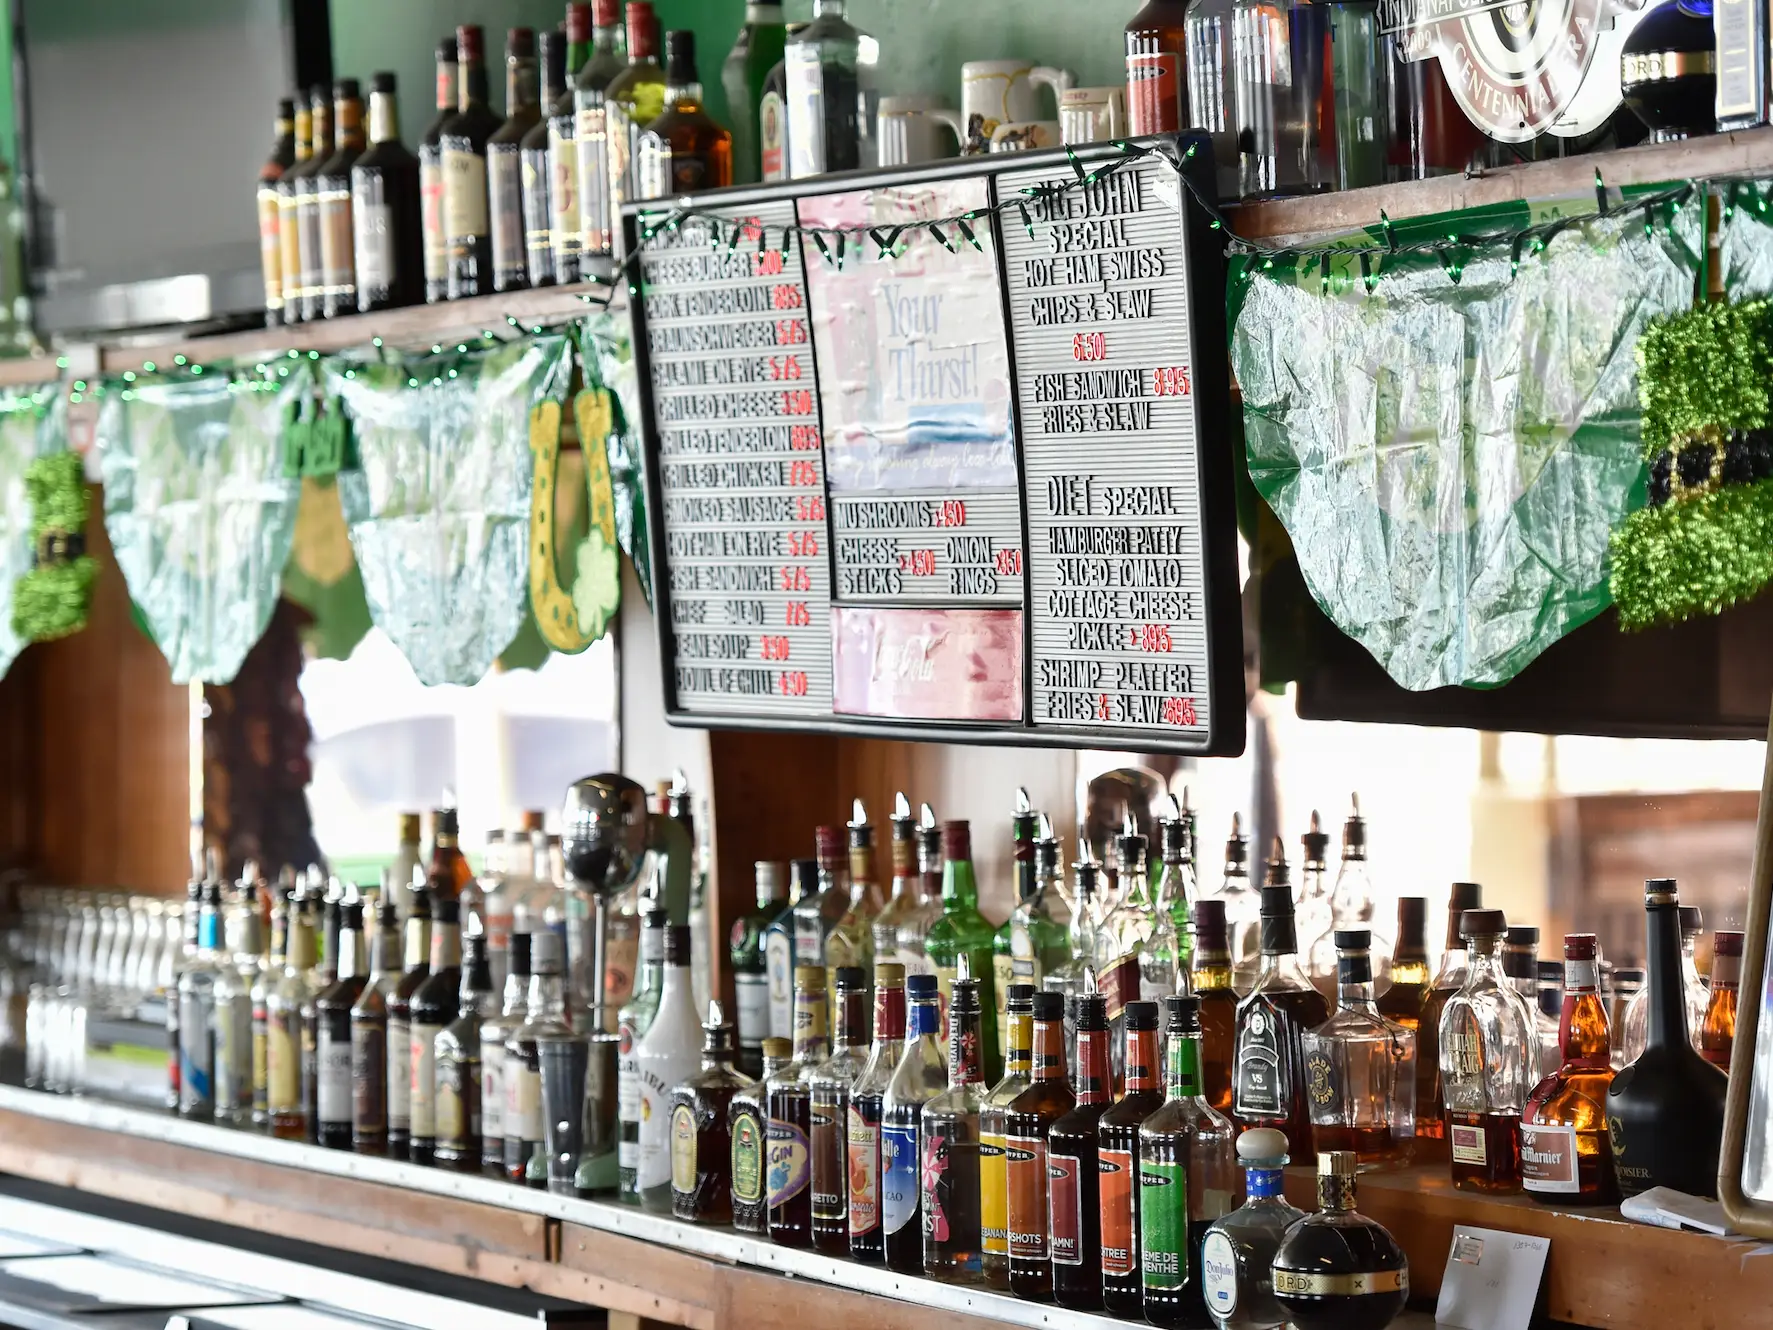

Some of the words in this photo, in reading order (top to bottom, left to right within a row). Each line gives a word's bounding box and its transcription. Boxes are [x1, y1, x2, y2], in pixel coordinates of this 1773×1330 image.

[1079, 170, 1141, 219] JOHN
[1048, 219, 1129, 254] SPECIAL
[1023, 258, 1054, 288] HOT
[1108, 248, 1163, 281] SWISS
[684, 285, 771, 315] TENDERLOIN
[882, 285, 943, 338] Your
[1030, 293, 1080, 326] CHIPS
[1086, 293, 1099, 322] &
[1104, 289, 1152, 321] SLAW
[889, 343, 978, 401] Thirst!
[1033, 373, 1066, 403] FISH
[1074, 368, 1144, 400] SANDWICH
[719, 391, 778, 418] CHEESE
[1042, 404, 1084, 433] FRIES
[1089, 403, 1101, 432] &
[1104, 401, 1152, 430] SLAW
[712, 426, 791, 454] TENDERLOIN
[720, 461, 784, 487] CHICKEN
[666, 497, 722, 523] SMOKED
[726, 496, 793, 522] SAUSAGE
[1047, 475, 1097, 515] DIET
[1101, 487, 1180, 516] SPECIAL
[836, 501, 932, 528] MUSHROOMS
[752, 531, 782, 557] RYE
[839, 538, 899, 564] CHEESE
[945, 537, 994, 564] ONION
[1048, 526, 1130, 555] HAMBURGER
[1136, 526, 1184, 555] PATTY
[705, 566, 774, 591] SANDWICH
[843, 567, 902, 595] STICKS
[949, 567, 998, 595] RINGS
[1056, 557, 1111, 587] SLICED
[1117, 558, 1182, 588] TOMATO
[1047, 590, 1119, 619] COTTAGE
[1128, 590, 1193, 620] CHEESE
[712, 635, 751, 660] SOUP
[1067, 622, 1125, 651] PICKLE
[1039, 659, 1101, 689] SHRIMP
[1114, 662, 1193, 693] PLATTER
[1047, 691, 1094, 721] FRIES
[1097, 693, 1110, 721] &
[1114, 694, 1163, 724] SLAW
[1252, 1074, 1263, 1083] VS
[1308, 1056, 1331, 1074] BLADE
[1163, 1252, 1178, 1263] DE
